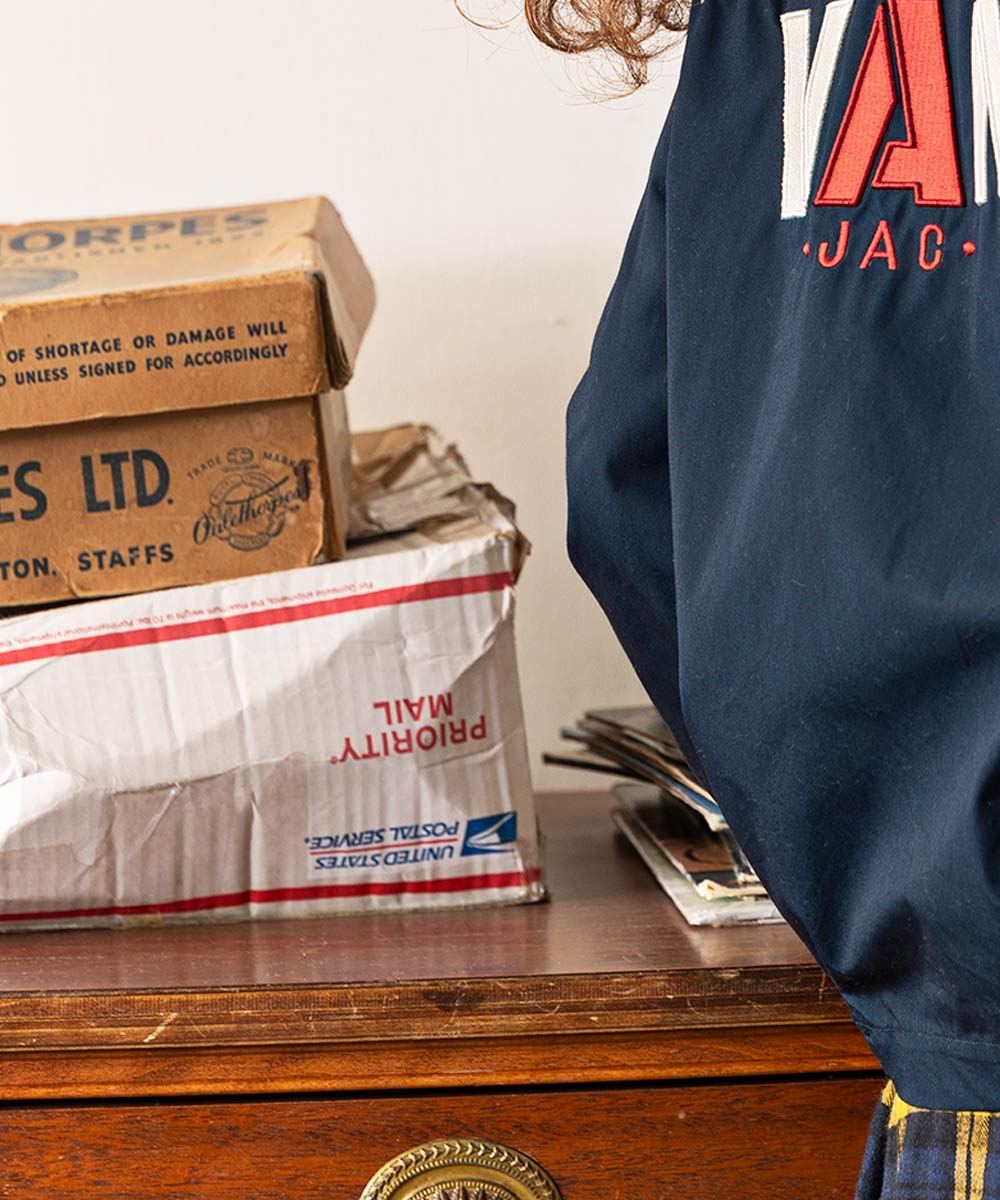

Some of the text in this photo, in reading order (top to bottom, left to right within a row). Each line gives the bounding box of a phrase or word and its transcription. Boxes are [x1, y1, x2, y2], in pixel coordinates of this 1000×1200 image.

[817, 220, 944, 271] JAC
[6, 320, 288, 364] OF SHORTAGE OR DAMAGE WILL
[15, 367, 69, 386] UNLESS
[79, 360, 136, 379] SIGNED
[146, 356, 174, 372] FOR
[184, 343, 288, 368] ACCORDINGLY
[80, 448, 174, 513] LTD.
[187, 455, 221, 480] TRADE
[0, 543, 174, 581] TON. STAFFS
[373, 692, 454, 725] MAIL
[339, 714, 487, 763] PRIORITY
[390, 820, 460, 841] POSTAL
[314, 845, 455, 870] UNITED STATES
